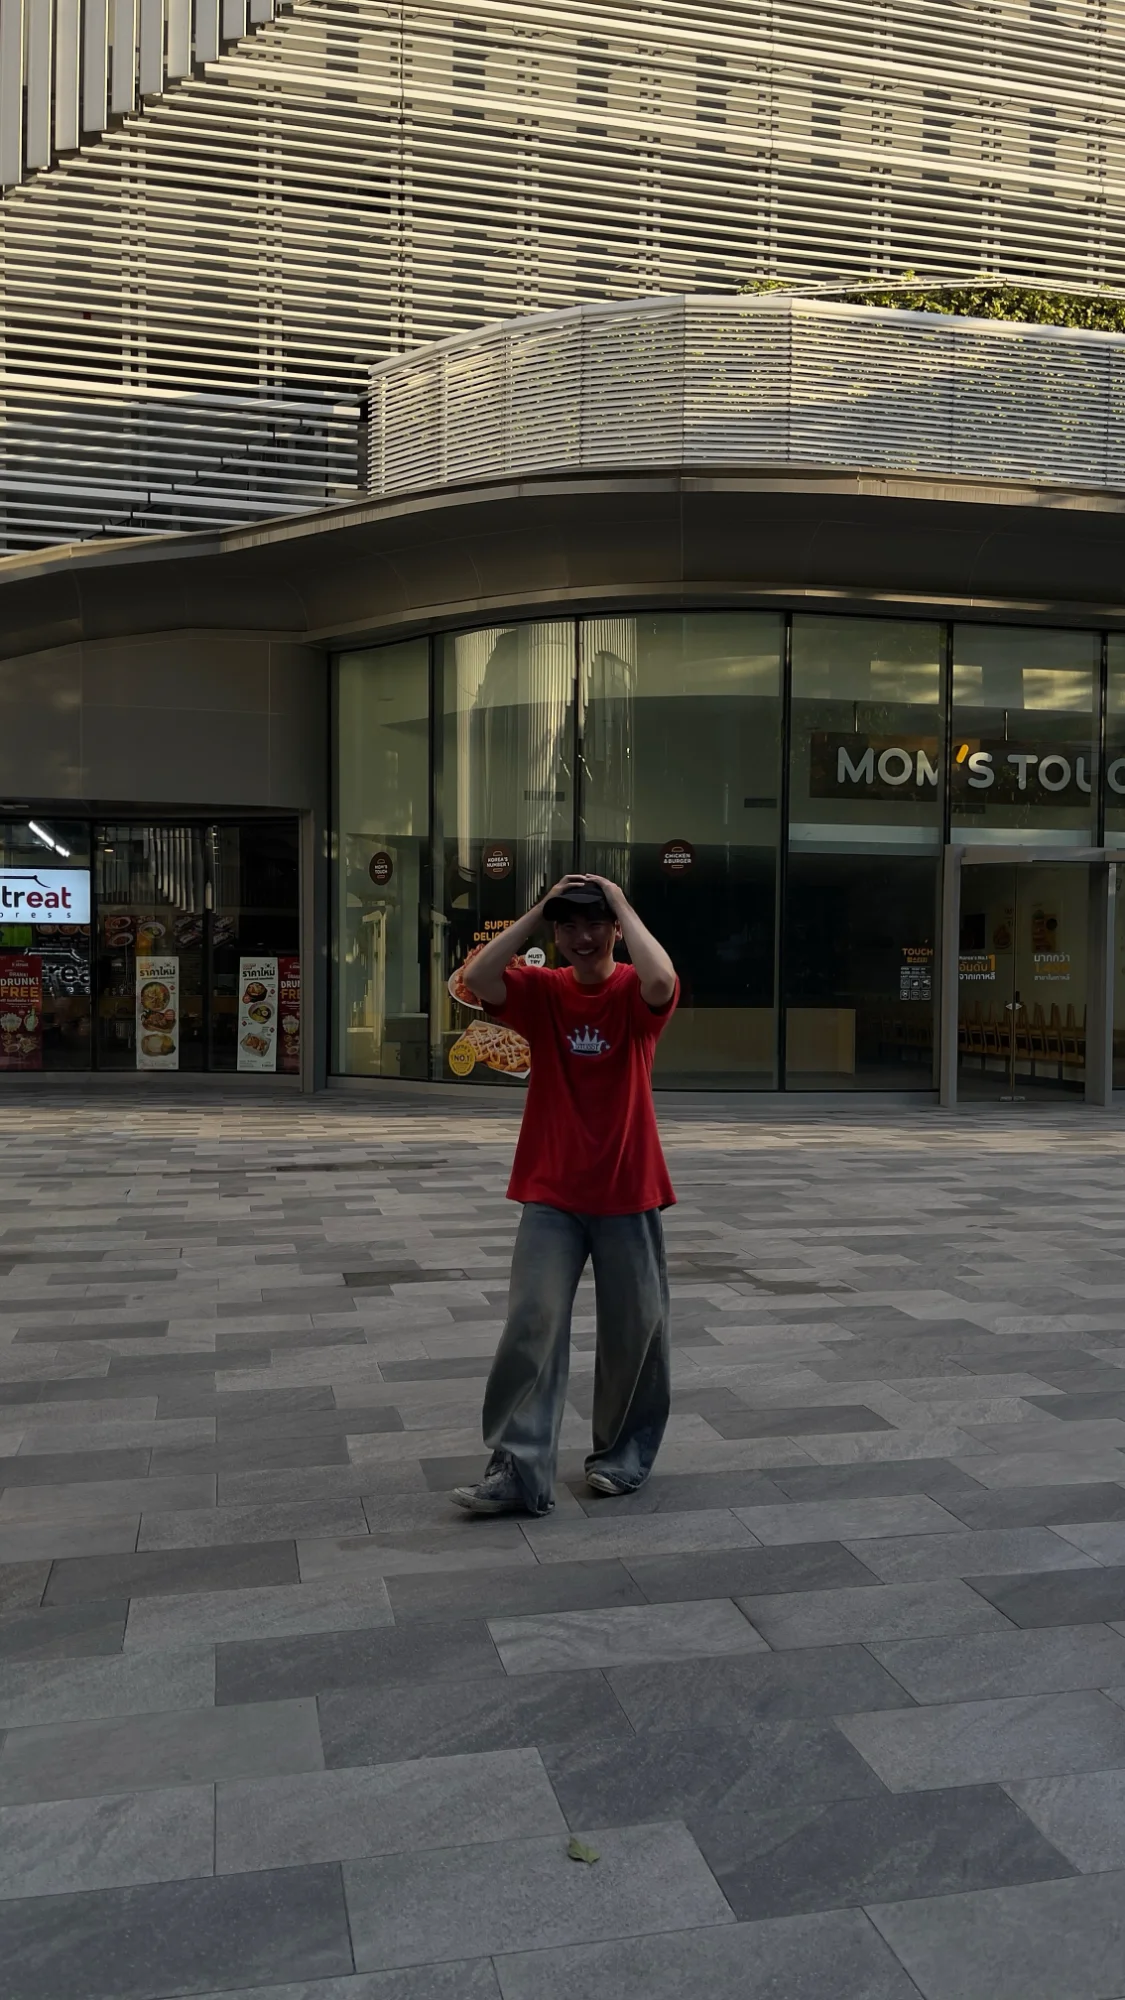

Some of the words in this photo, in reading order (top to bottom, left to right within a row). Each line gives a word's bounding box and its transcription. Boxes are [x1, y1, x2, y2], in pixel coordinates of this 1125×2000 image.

[837, 743, 995, 789] MOM'S
[2, 885, 72, 909] treat
[901, 947, 934, 956] TOUCH
[959, 961, 988, 972] อันดับ
[987, 953, 996, 972] 1
[1034, 952, 1071, 963] มากกว่า
[139, 965, 176, 977] ราคาใหม่
[242, 966, 276, 978] ราคาใหม่
[958, 972, 996, 980] จากเกาหลี
[0, 976, 39, 986] DRUNK!
[0, 986, 39, 997] FREE
